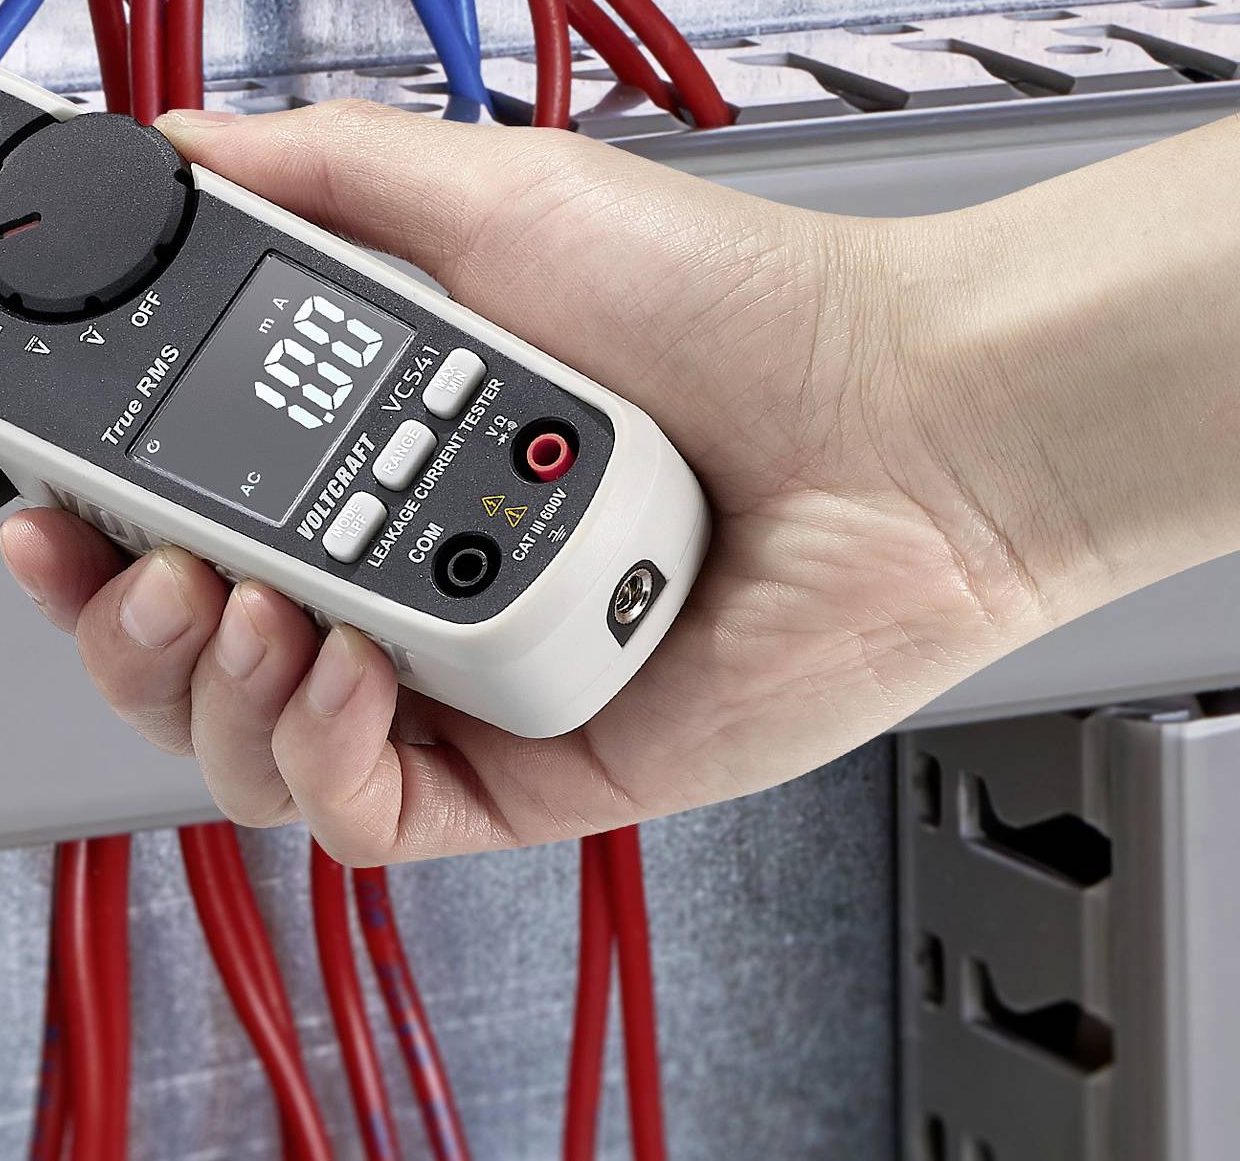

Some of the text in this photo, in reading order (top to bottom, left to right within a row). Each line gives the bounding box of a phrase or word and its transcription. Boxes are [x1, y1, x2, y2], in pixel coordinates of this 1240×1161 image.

[130, 290, 162, 329] OFF
[100, 343, 181, 448] True RMS
[380, 345, 441, 414] VC541
[366, 378, 505, 568] LEAKAGE CURRENT TESTER
[381, 428, 422, 475] RANGE
[240, 471, 262, 497] AC
[295, 432, 377, 542] VOLTCRAFT
[330, 502, 361, 538] MODE
[408, 522, 444, 563] COM
[512, 532, 536, 561] CAT
[540, 487, 567, 520] 600V
